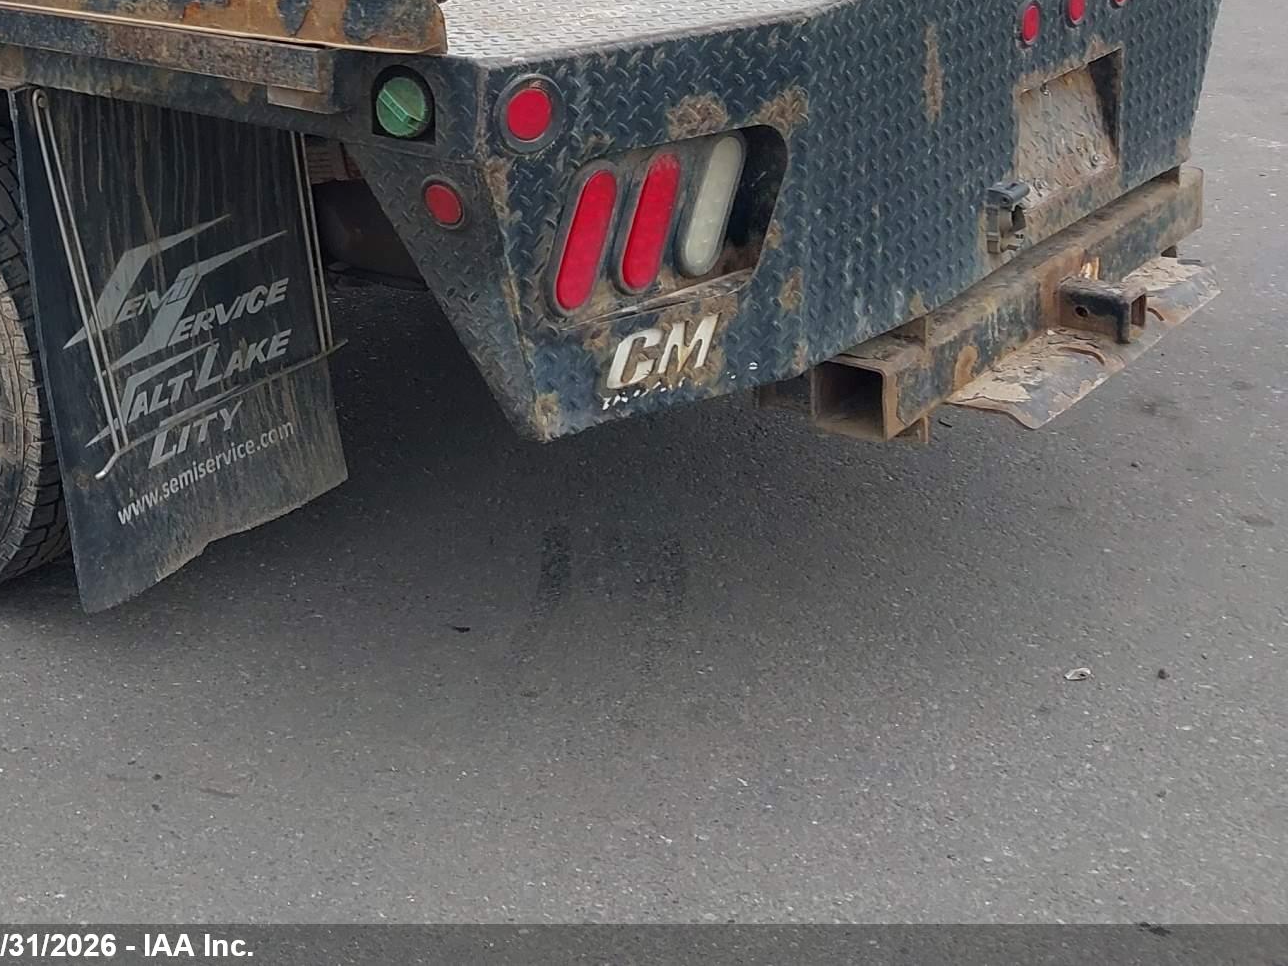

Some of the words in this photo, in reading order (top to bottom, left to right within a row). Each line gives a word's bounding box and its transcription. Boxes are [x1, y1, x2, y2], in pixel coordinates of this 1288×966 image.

[195, 329, 292, 392] LAKE
[606, 312, 722, 389] CM
[118, 421, 295, 524] www.semiservice.com
